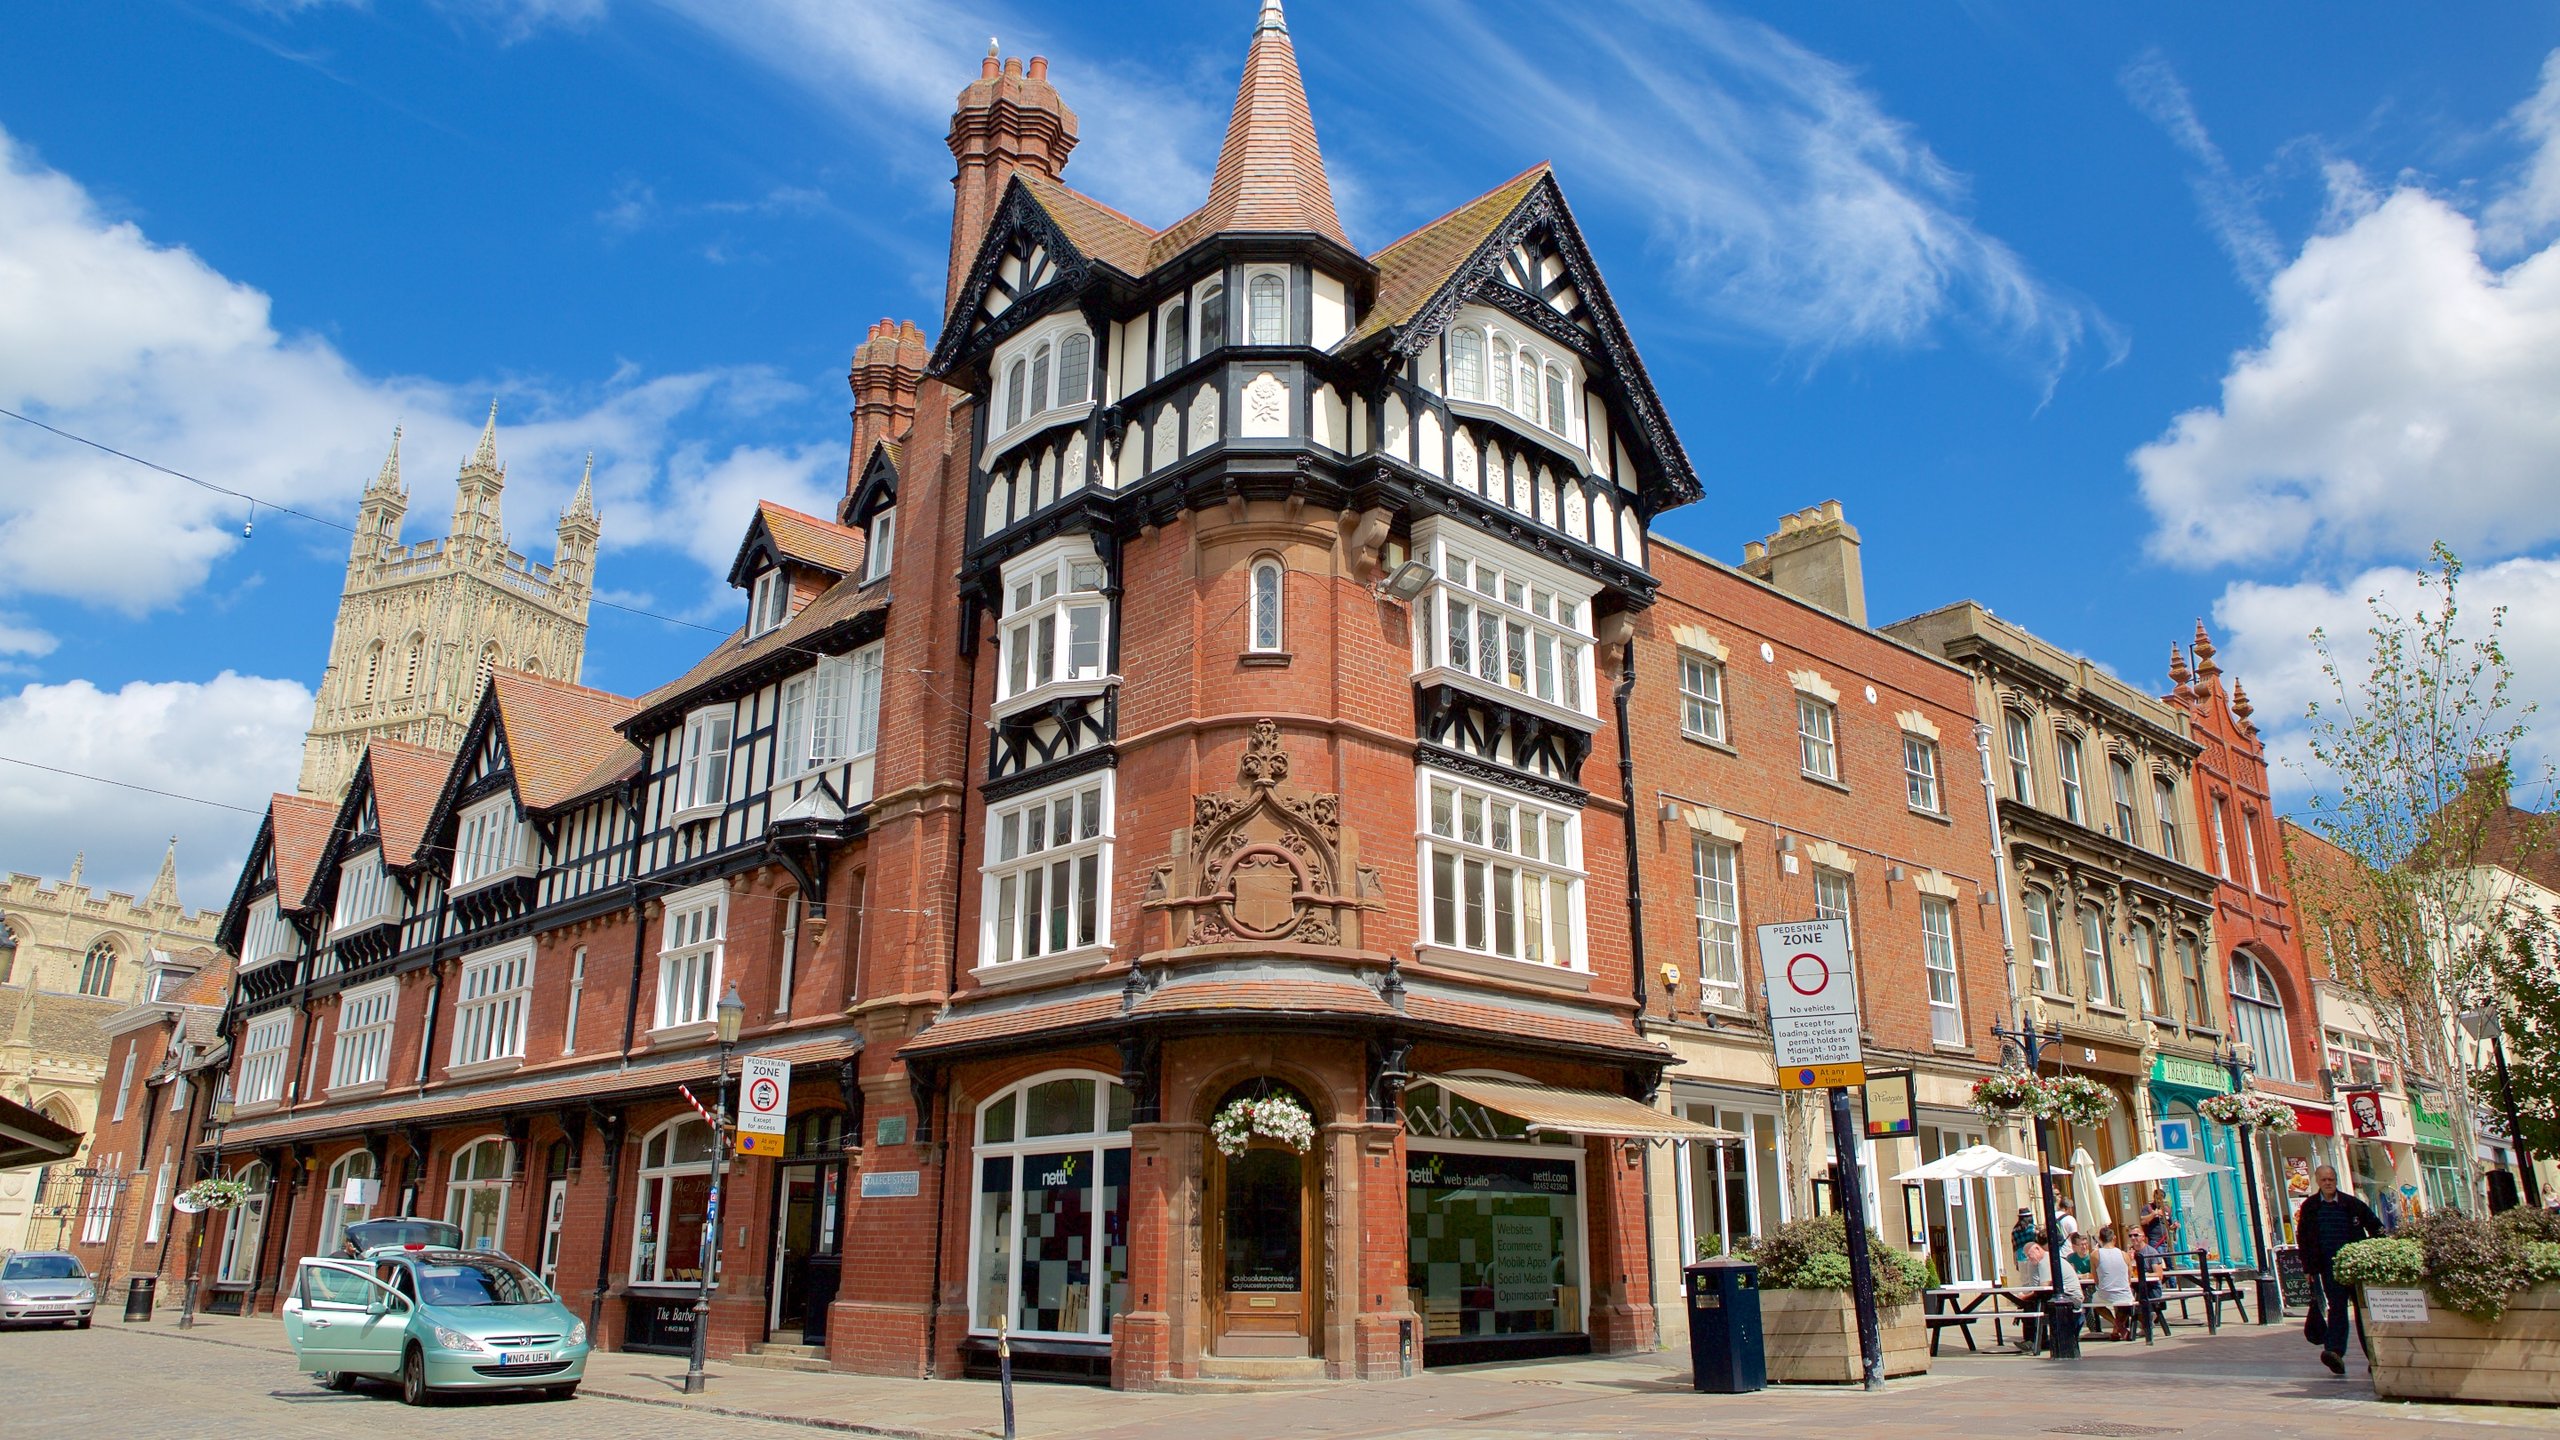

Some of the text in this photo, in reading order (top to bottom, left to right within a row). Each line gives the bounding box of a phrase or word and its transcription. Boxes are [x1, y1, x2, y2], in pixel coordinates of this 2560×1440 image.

[1773, 923, 1829, 934] PEDESTRIAN
[1783, 932, 1823, 946] ZONE
[1803, 1004, 1835, 1013] vehicles
[1794, 1020, 1821, 1029] Except
[1812, 1028, 1837, 1036] cycles
[1838, 1026, 1853, 1034] and
[1788, 1036, 1846, 1047] permit holders
[1787, 1046, 1822, 1054] Midnight
[2084, 1047, 2096, 1063] 54
[748, 1057, 786, 1067] PEDESTRIAN
[1815, 1052, 1850, 1062] Midnight
[753, 1066, 780, 1077] ZONE
[1831, 1069, 1845, 1077] any
[2166, 1060, 2199, 1084] TREASURE
[753, 1116, 772, 1124] Except
[864, 1174, 917, 1186] COLLEGE STREET
[1042, 1169, 1068, 1186] nettl
[1406, 1167, 1490, 1187] nettl web studio
[1532, 1170, 1568, 1183] nettl.com
[1497, 1223, 1534, 1235] Websites
[1497, 1239, 1543, 1251] Ecommerce
[1498, 1255, 1547, 1270] Mobile Apps
[1498, 1272, 1548, 1284] Social Media
[1499, 1289, 1550, 1303] Optimisation
[657, 1306, 670, 1320] The
[506, 1352, 550, 1364] WN04 UEW
